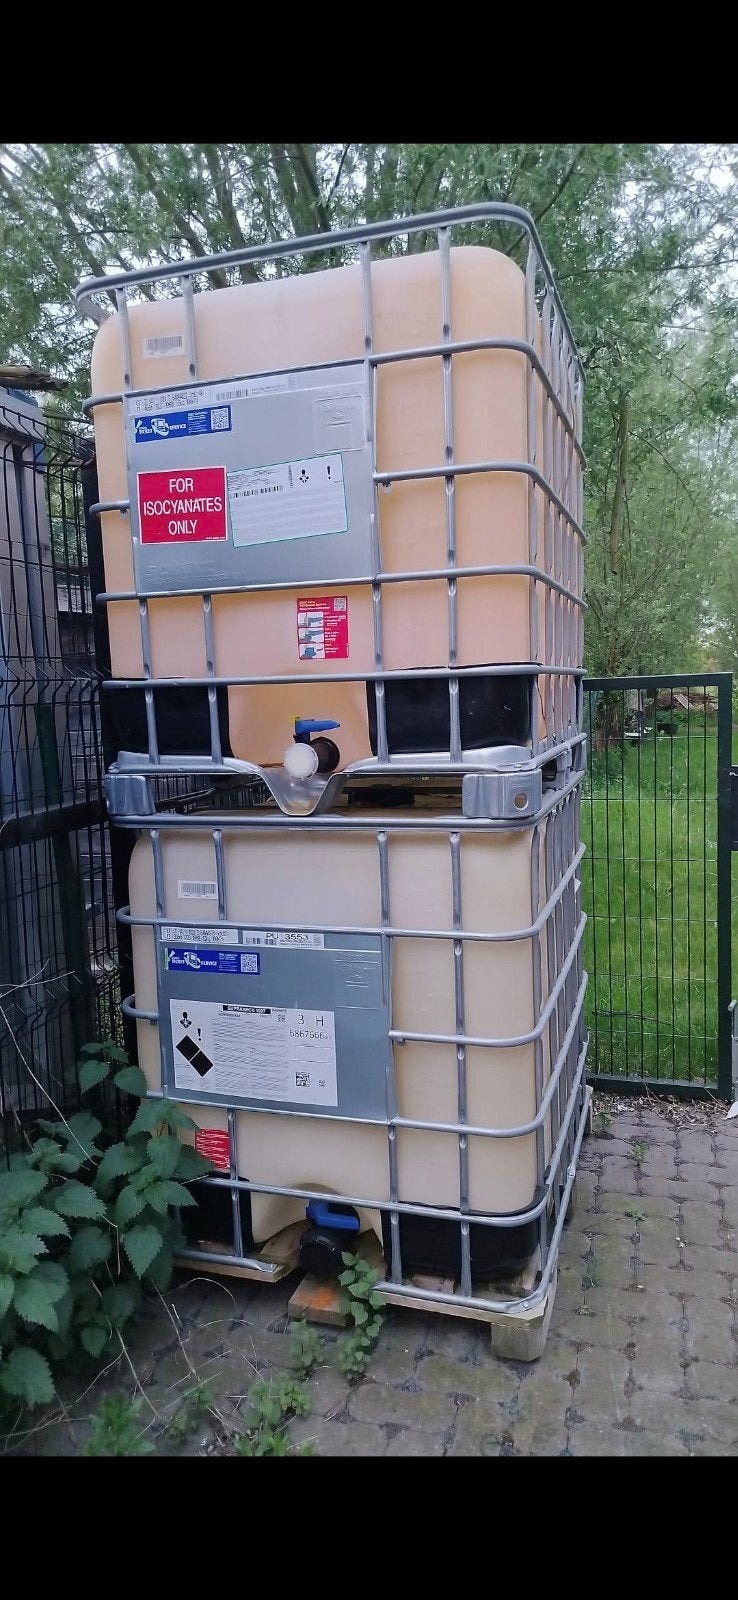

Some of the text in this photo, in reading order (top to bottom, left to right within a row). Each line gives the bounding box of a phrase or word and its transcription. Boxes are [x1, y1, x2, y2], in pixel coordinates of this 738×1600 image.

[169, 477, 194, 493] FOR
[143, 496, 222, 516] ISOCYANATES
[168, 519, 198, 535] ONLY
[265, 932, 309, 941] PU 3553
[298, 1014, 324, 1026] 3 H
